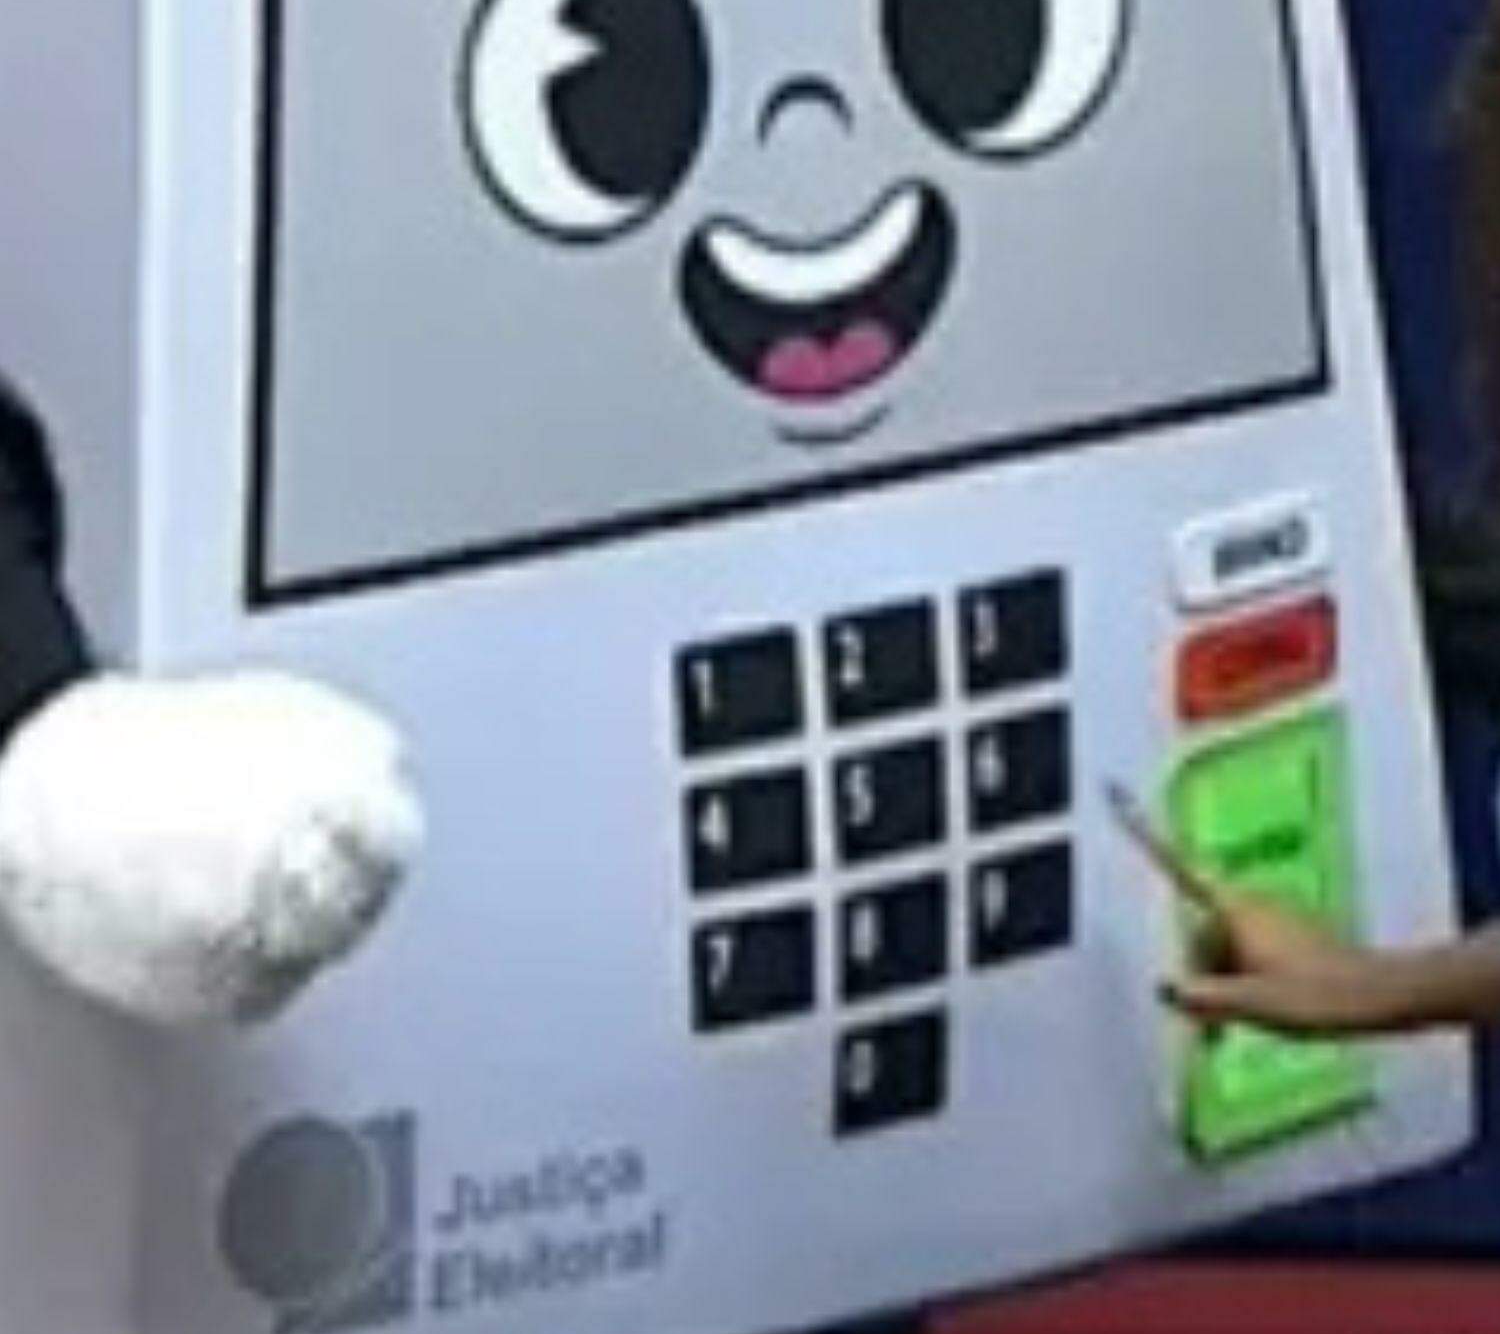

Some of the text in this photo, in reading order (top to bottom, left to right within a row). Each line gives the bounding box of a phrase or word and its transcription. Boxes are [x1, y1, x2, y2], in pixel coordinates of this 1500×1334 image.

[691, 597, 997, 719] 1 2 3
[700, 792, 732, 854] 4
[844, 763, 875, 828] 5
[707, 933, 734, 997] 7
[848, 1038, 877, 1097] 0
[433, 1145, 645, 1234] Justiça
[431, 1210, 667, 1313] Eleitoral
